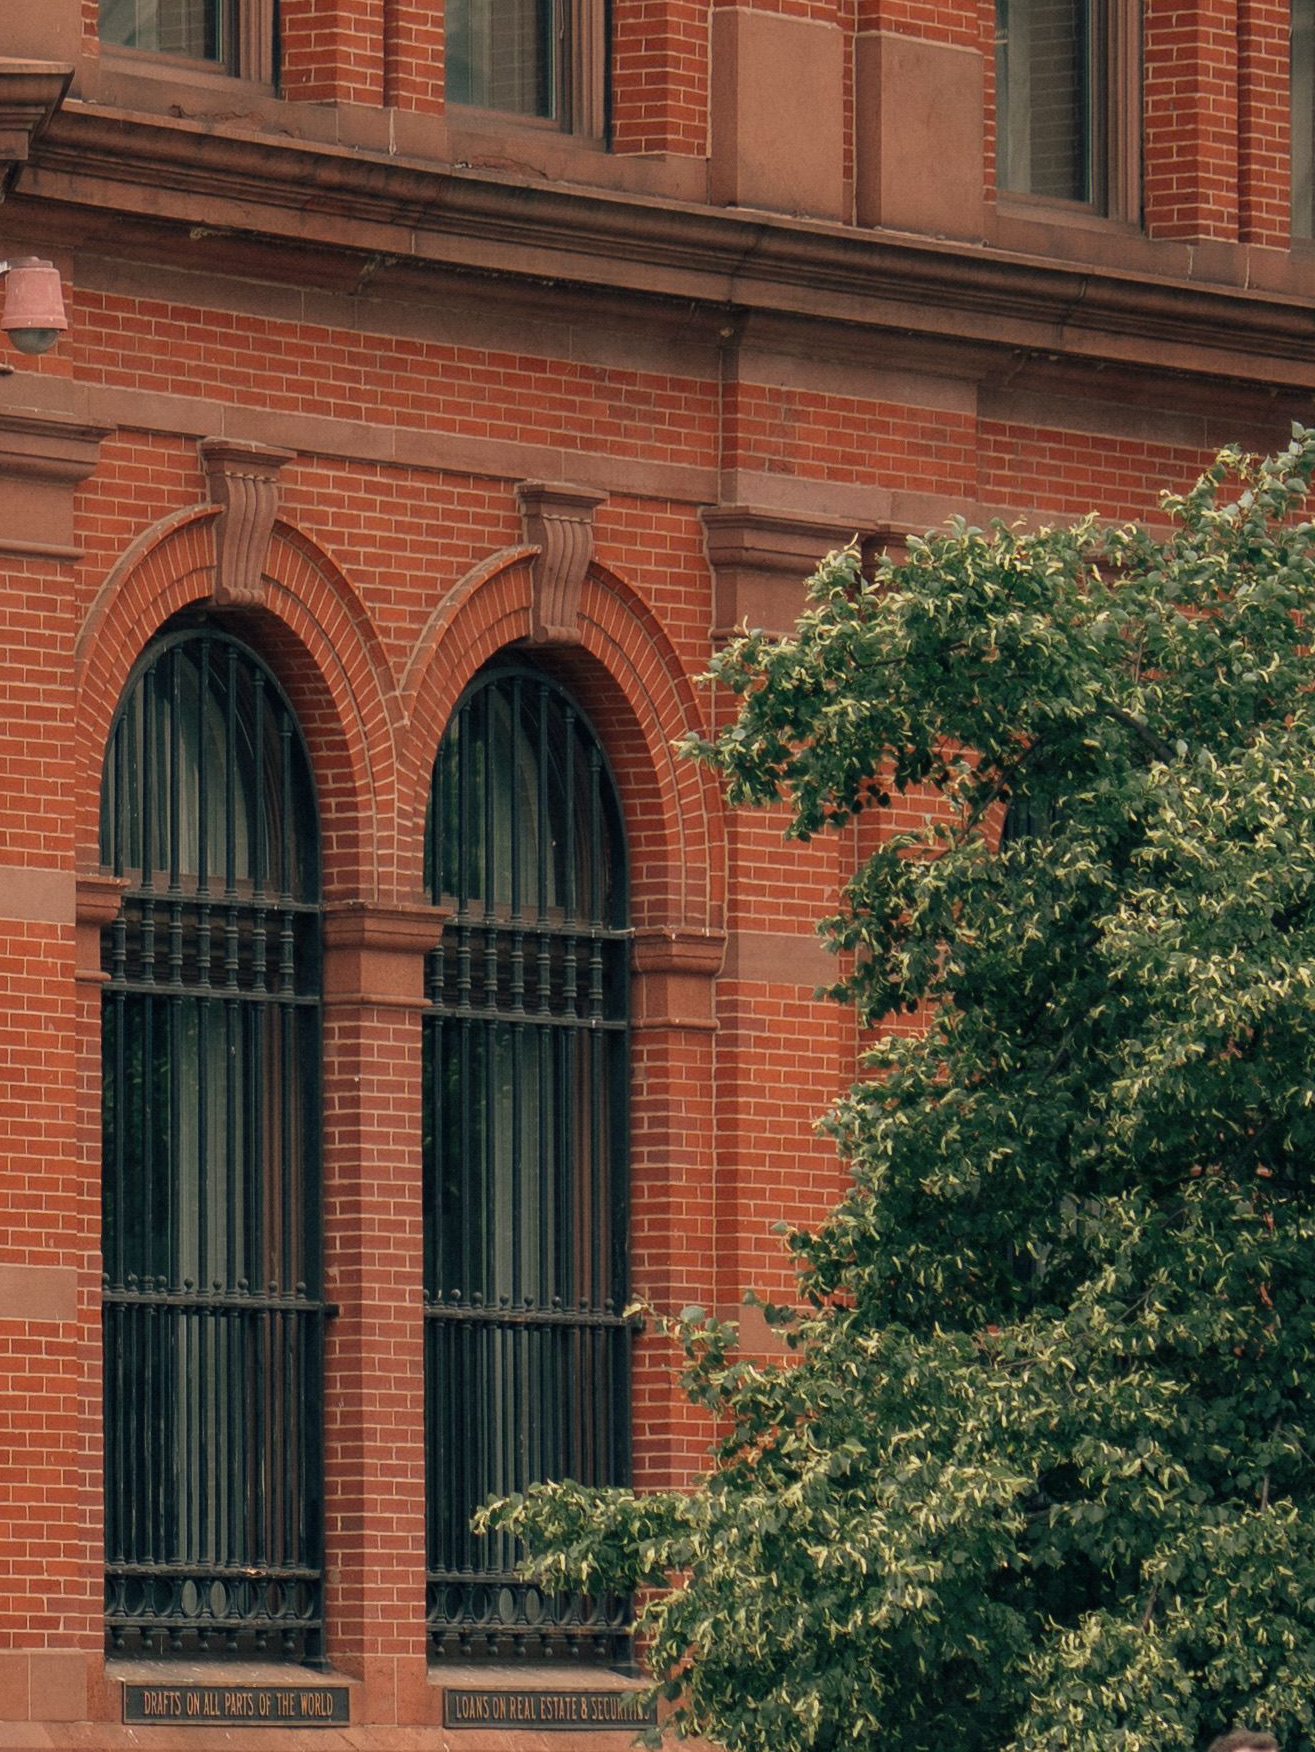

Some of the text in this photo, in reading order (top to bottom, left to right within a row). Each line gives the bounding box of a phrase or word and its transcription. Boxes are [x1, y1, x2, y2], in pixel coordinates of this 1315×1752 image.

[143, 1691, 333, 1717] DRAFTS ON ALL PARTS OF THE WORLD
[455, 1695, 490, 1719] LOANS
[492, 1697, 507, 1719] ON
[509, 1696, 537, 1720] REAL
[540, 1696, 578, 1720] ESTATE
[580, 1697, 588, 1719] &
